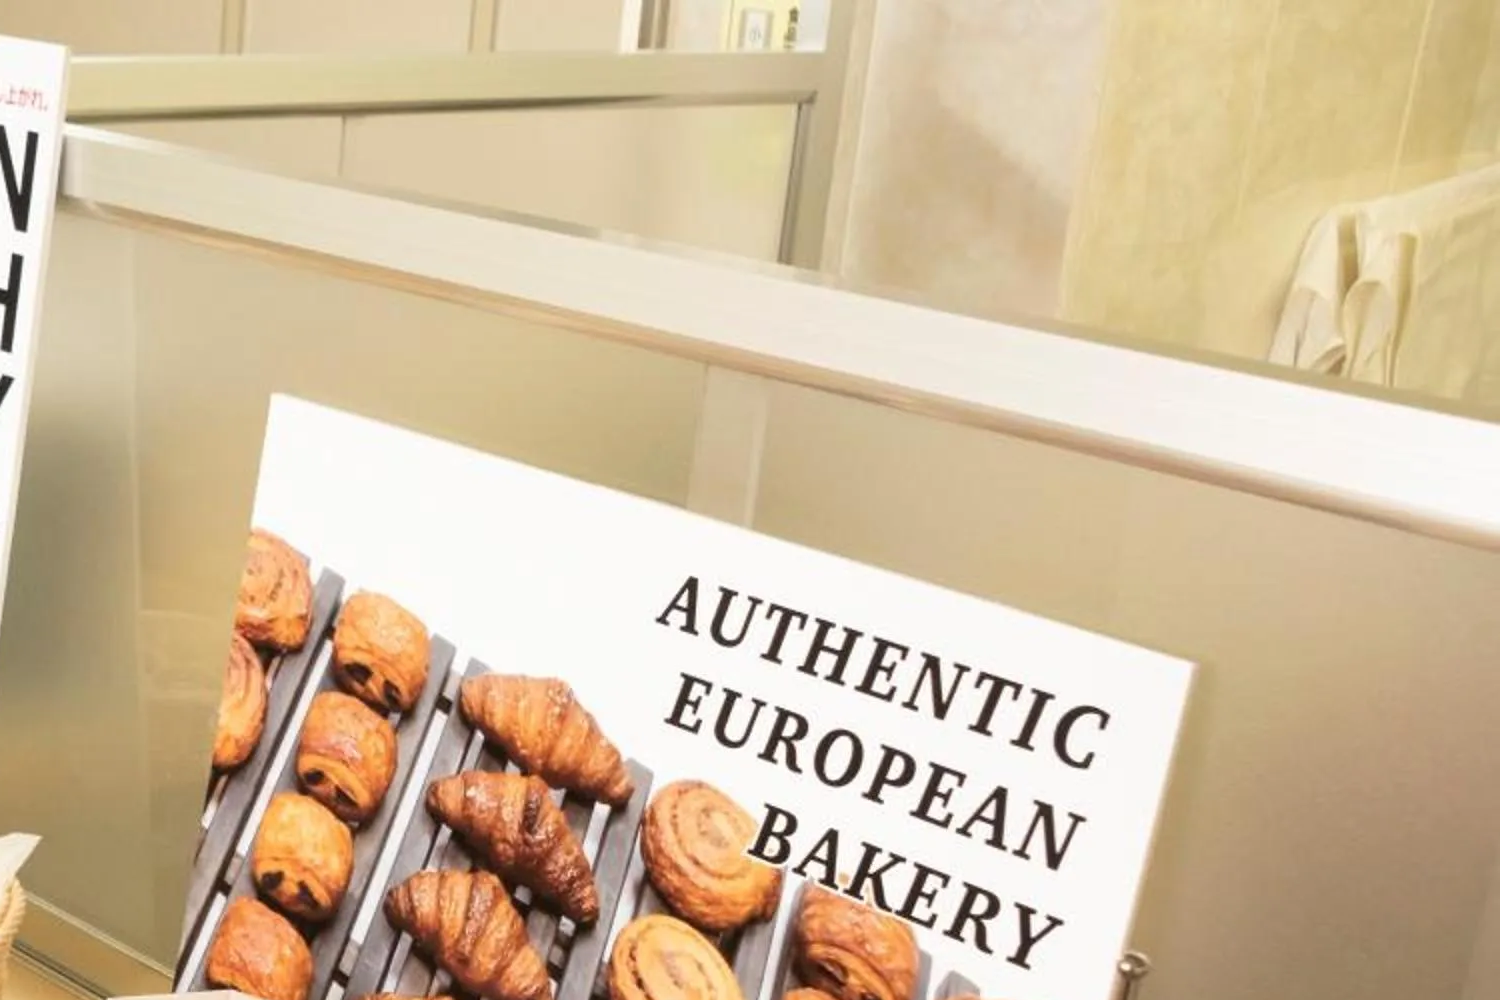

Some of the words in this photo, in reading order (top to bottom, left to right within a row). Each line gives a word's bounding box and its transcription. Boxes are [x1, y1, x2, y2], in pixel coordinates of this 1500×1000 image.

[655, 575, 1111, 770] AUTHENTIC
[664, 672, 1087, 871] EUROPEAN
[747, 802, 1064, 970] BAKERY
